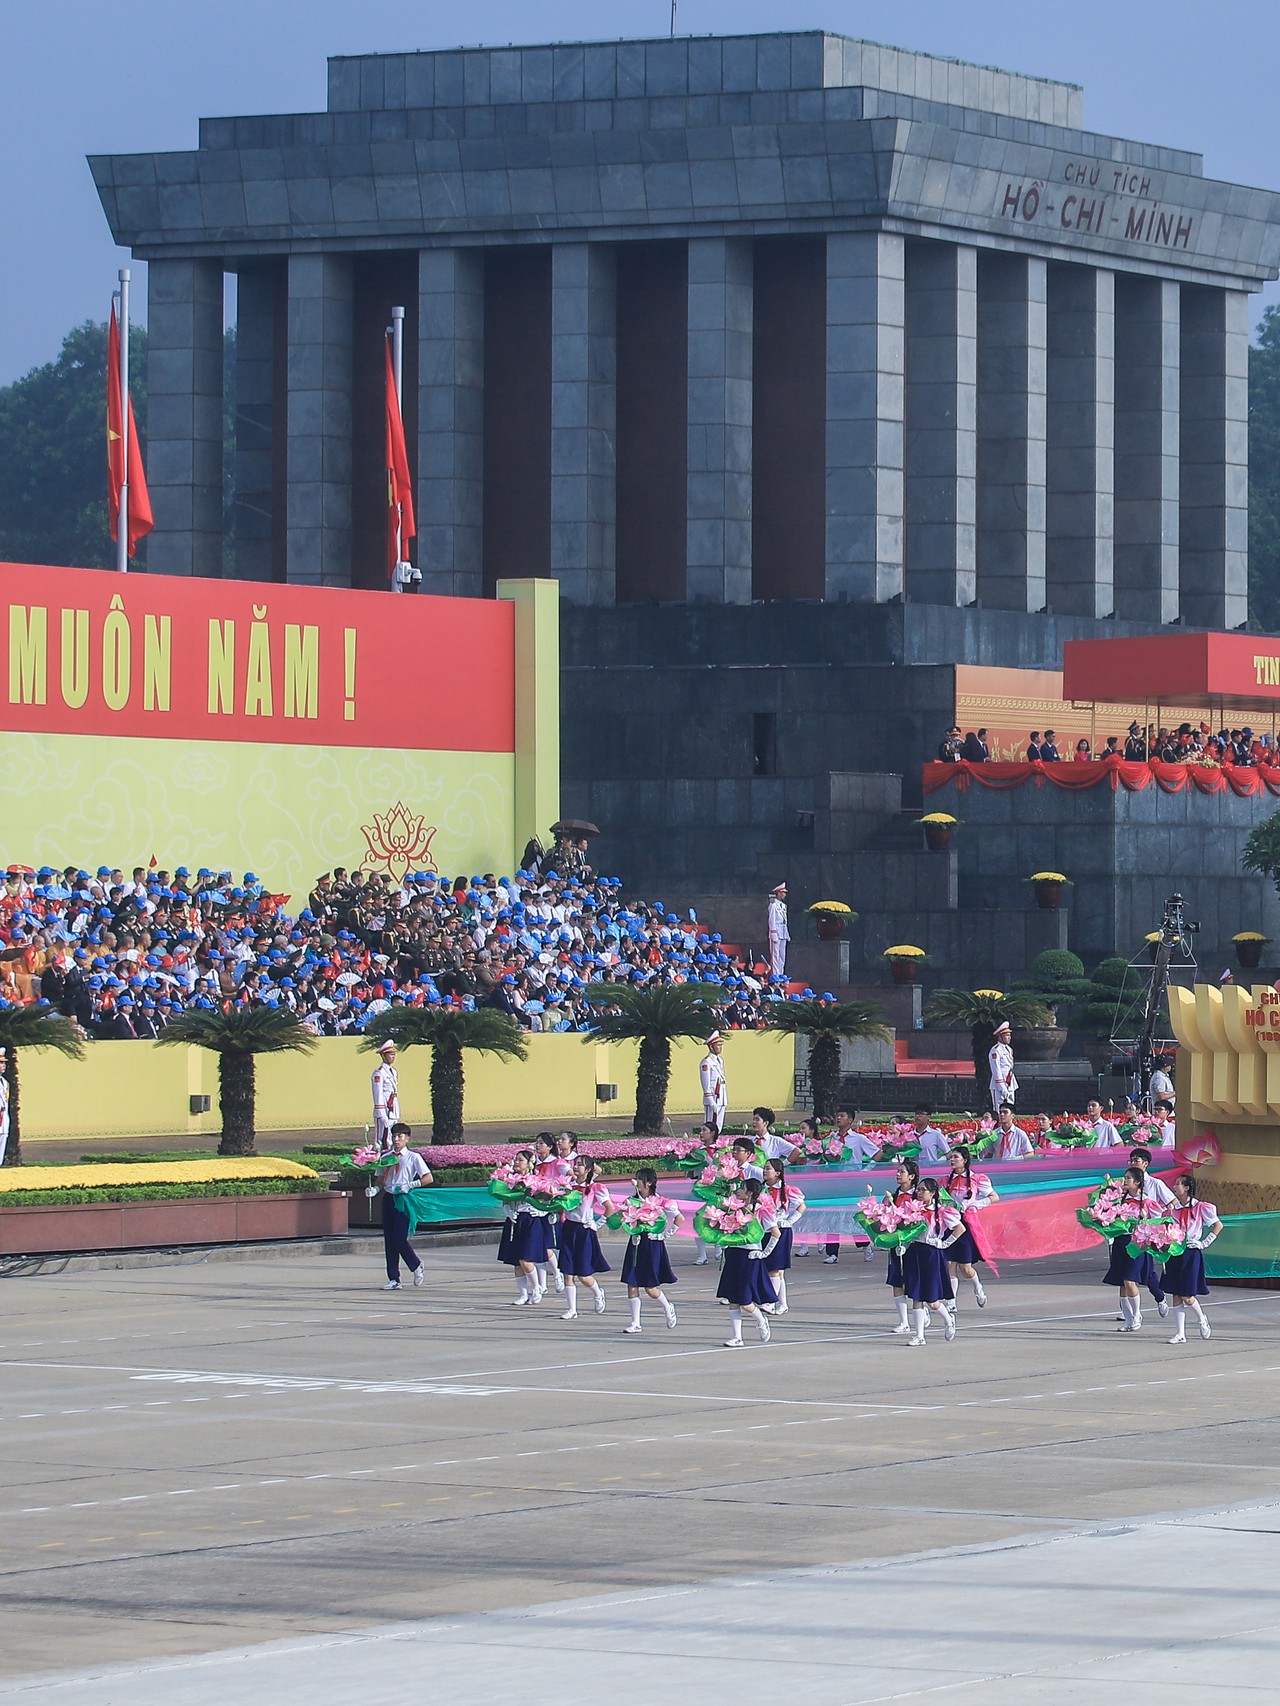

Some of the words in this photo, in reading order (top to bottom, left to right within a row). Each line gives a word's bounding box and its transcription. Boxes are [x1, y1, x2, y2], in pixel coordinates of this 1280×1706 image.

[1001, 181, 1045, 222] HỒ
[1061, 194, 1110, 234] CHÍ
[1124, 201, 1194, 249] MINH
[9, 593, 172, 711] MUÔN
[207, 604, 319, 719] NĂM
